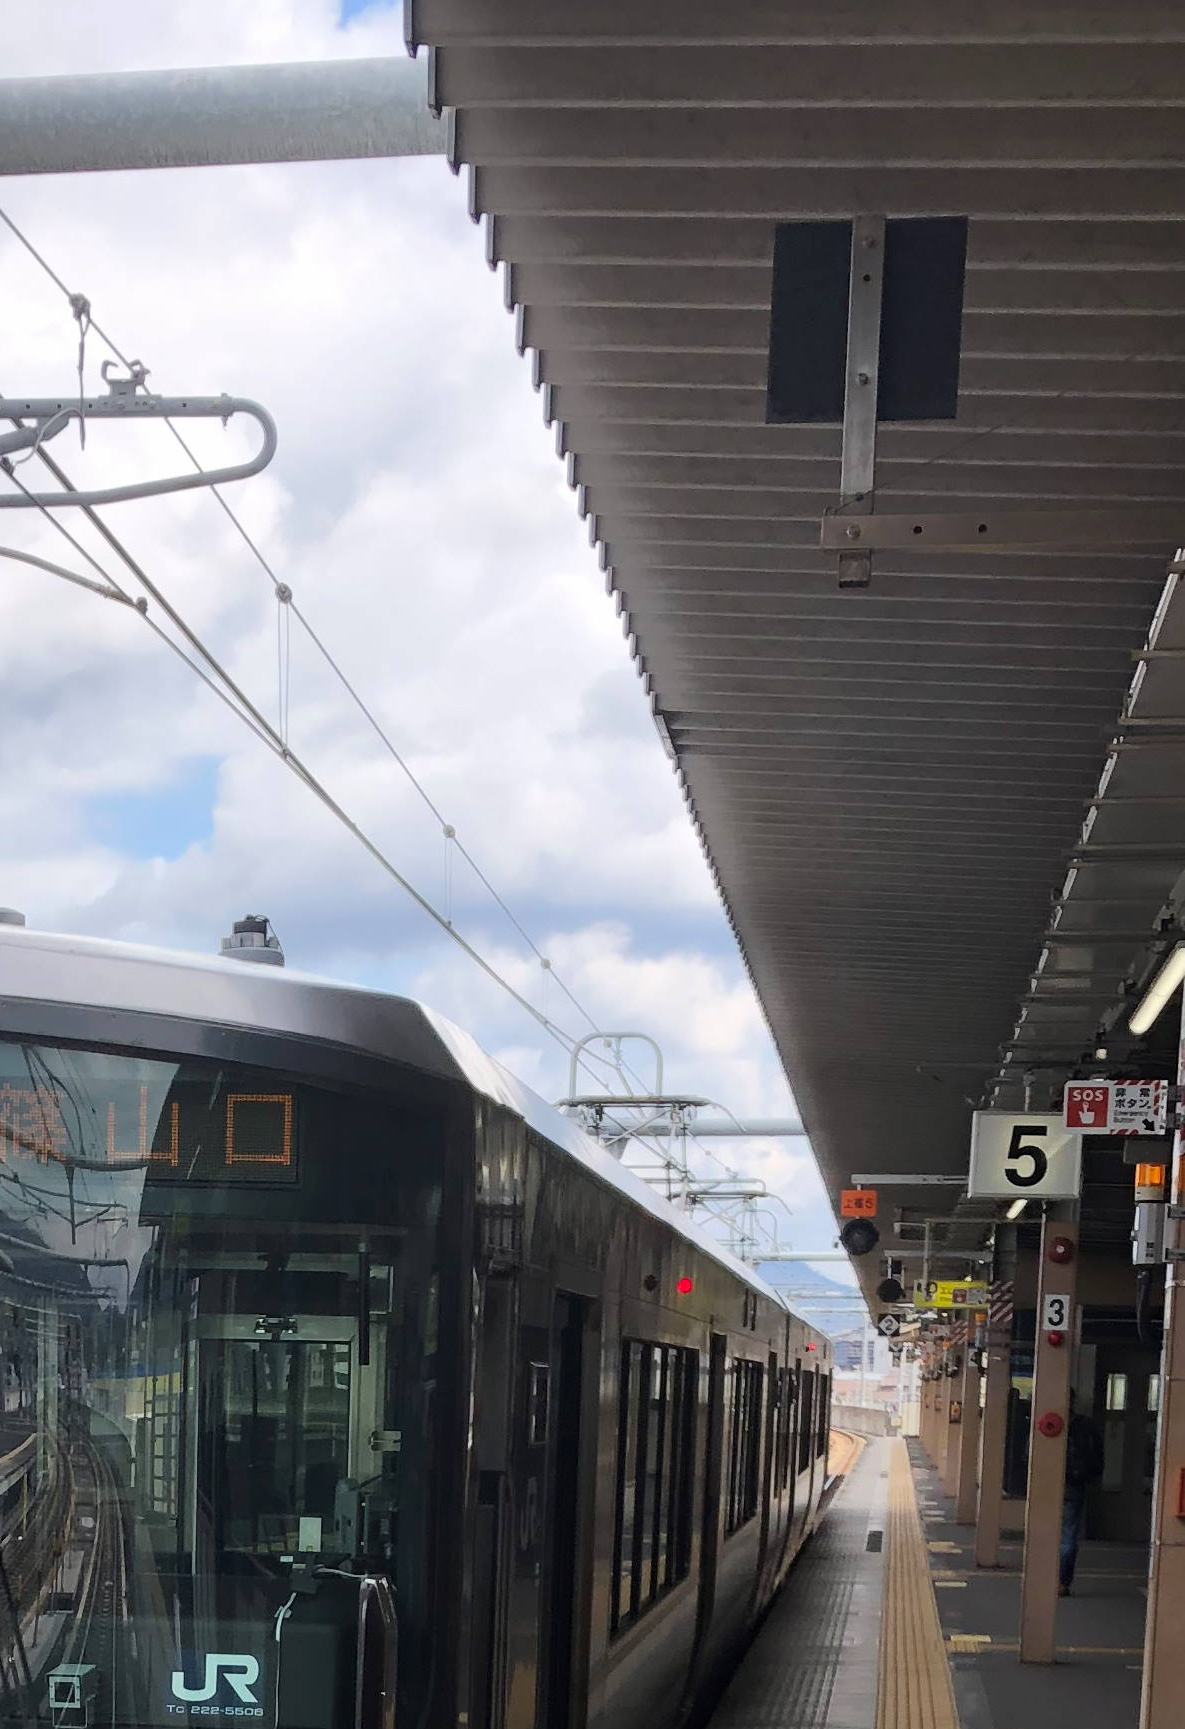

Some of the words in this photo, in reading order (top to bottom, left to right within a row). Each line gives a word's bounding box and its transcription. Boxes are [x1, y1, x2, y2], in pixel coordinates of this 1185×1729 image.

[1072, 1089, 1104, 1102] SOS
[1005, 1125, 1048, 1187] 5
[885, 1317, 894, 1330] 2
[1048, 1299, 1064, 1326] 3
[172, 1653, 259, 1703] JR
